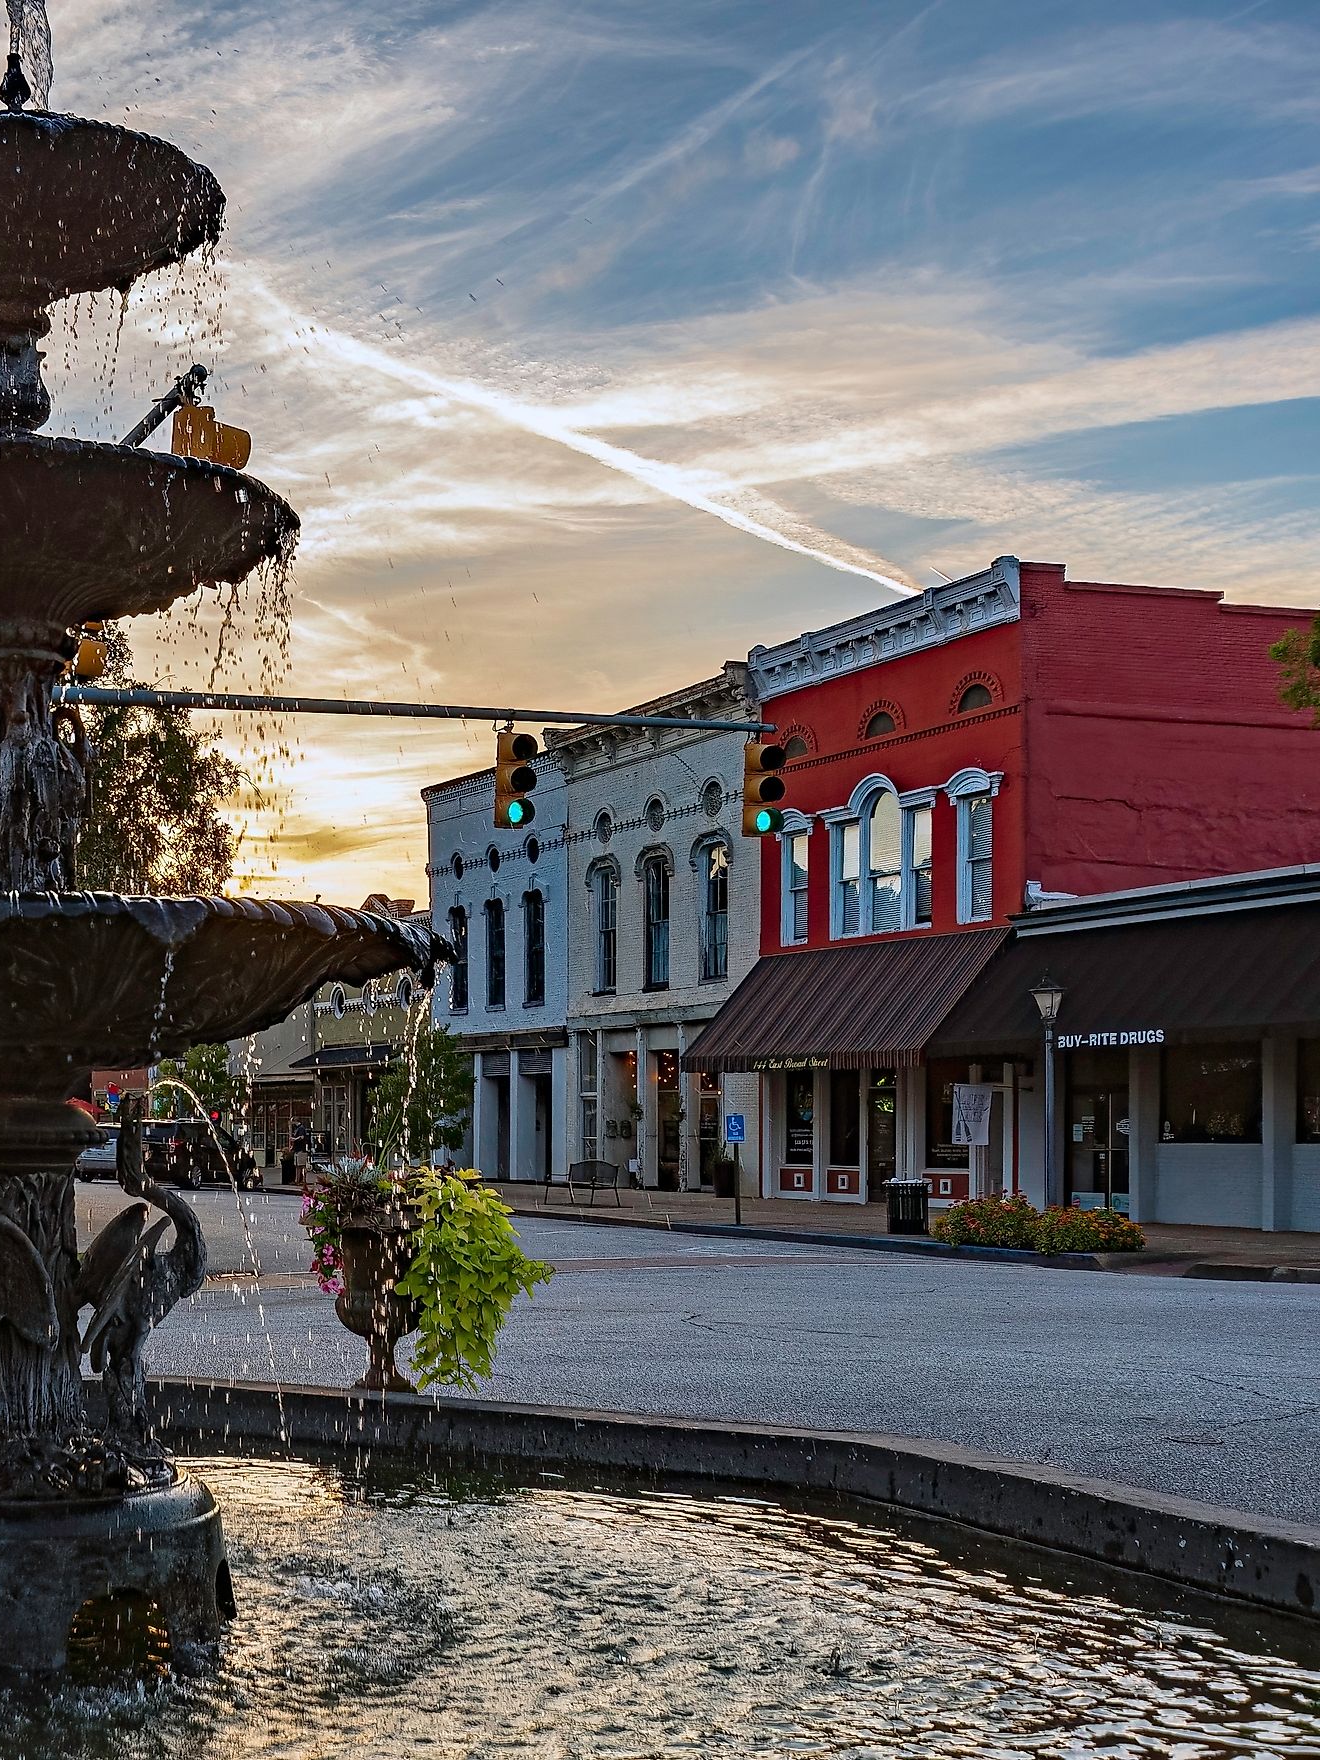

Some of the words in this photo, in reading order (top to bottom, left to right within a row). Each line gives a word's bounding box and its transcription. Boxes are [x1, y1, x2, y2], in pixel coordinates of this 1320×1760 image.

[1058, 1032, 1118, 1048] BUY-RITE
[1120, 1029, 1164, 1044] DRUGS
[769, 1058, 783, 1069] East
[784, 1057, 807, 1068] Broad
[809, 1056, 828, 1067] Street
